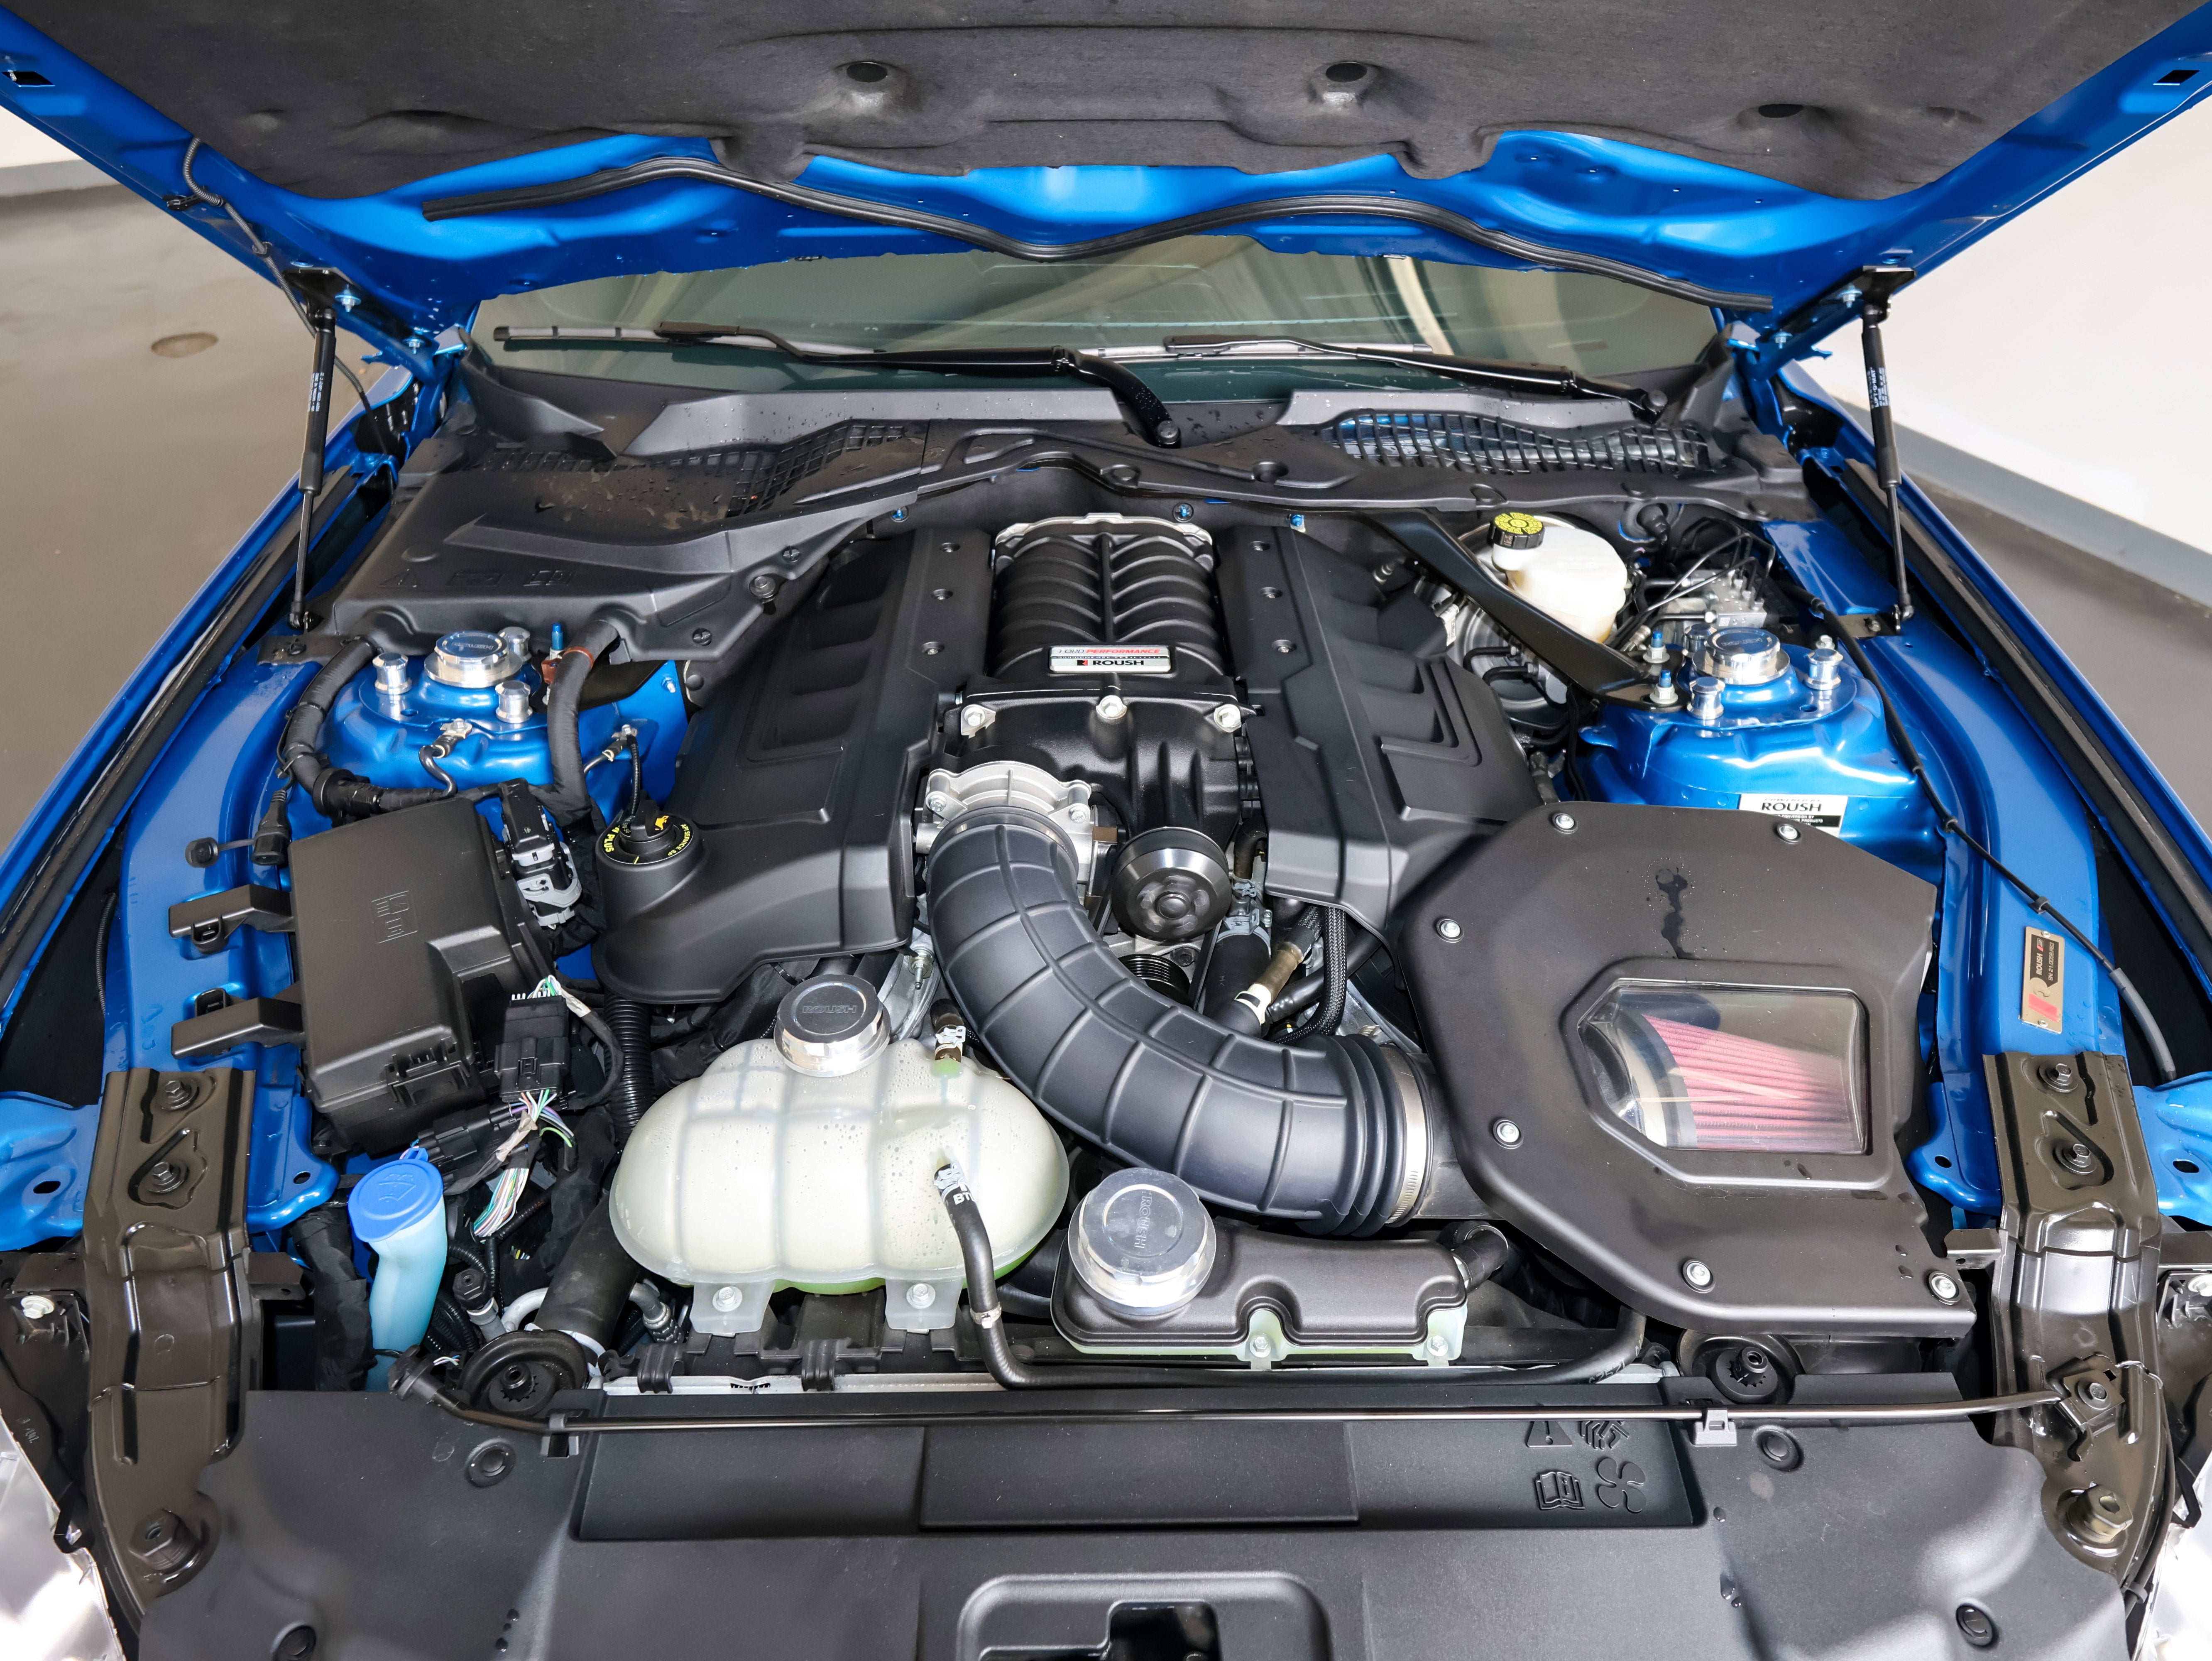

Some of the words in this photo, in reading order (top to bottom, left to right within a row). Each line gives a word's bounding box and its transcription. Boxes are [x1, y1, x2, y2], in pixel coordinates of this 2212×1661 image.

[1762, 802, 1822, 812] ROUSH
[604, 833, 615, 853] PLUS
[675, 831, 690, 850] SERVICE
[803, 1005, 858, 1014] ROUSH
[1134, 1196, 1152, 1248] ROUSH
